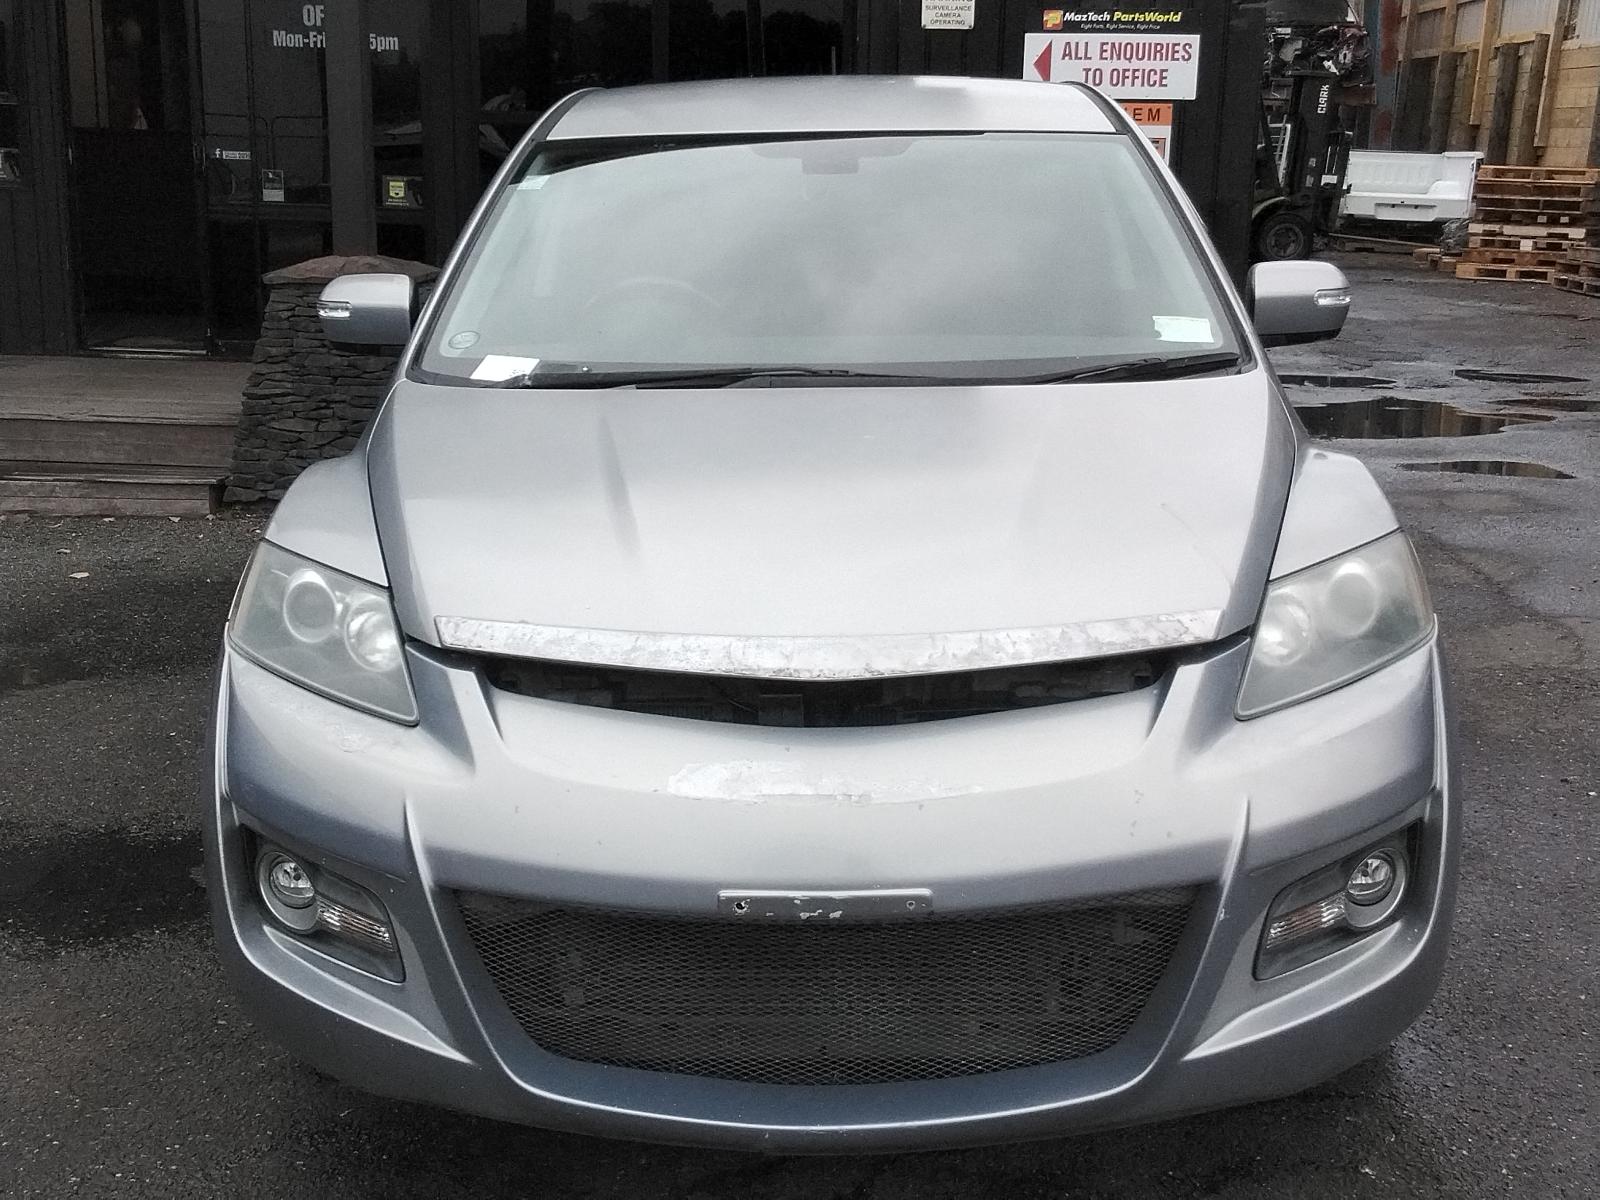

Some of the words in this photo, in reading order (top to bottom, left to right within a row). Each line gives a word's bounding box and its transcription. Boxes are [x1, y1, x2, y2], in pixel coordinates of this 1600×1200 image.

[1063, 12, 1110, 22] MazTech
[1113, 11, 1182, 22] PartsWorld
[272, 30, 326, 48] Mon-Fri
[1061, 41, 1093, 61] ALL
[1099, 41, 1193, 62] ENQUIRIES
[1082, 67, 1103, 87] TO
[1111, 68, 1169, 88] OFFICE
[1317, 84, 1330, 114] CLARK
[1132, 108, 1161, 122] EM
